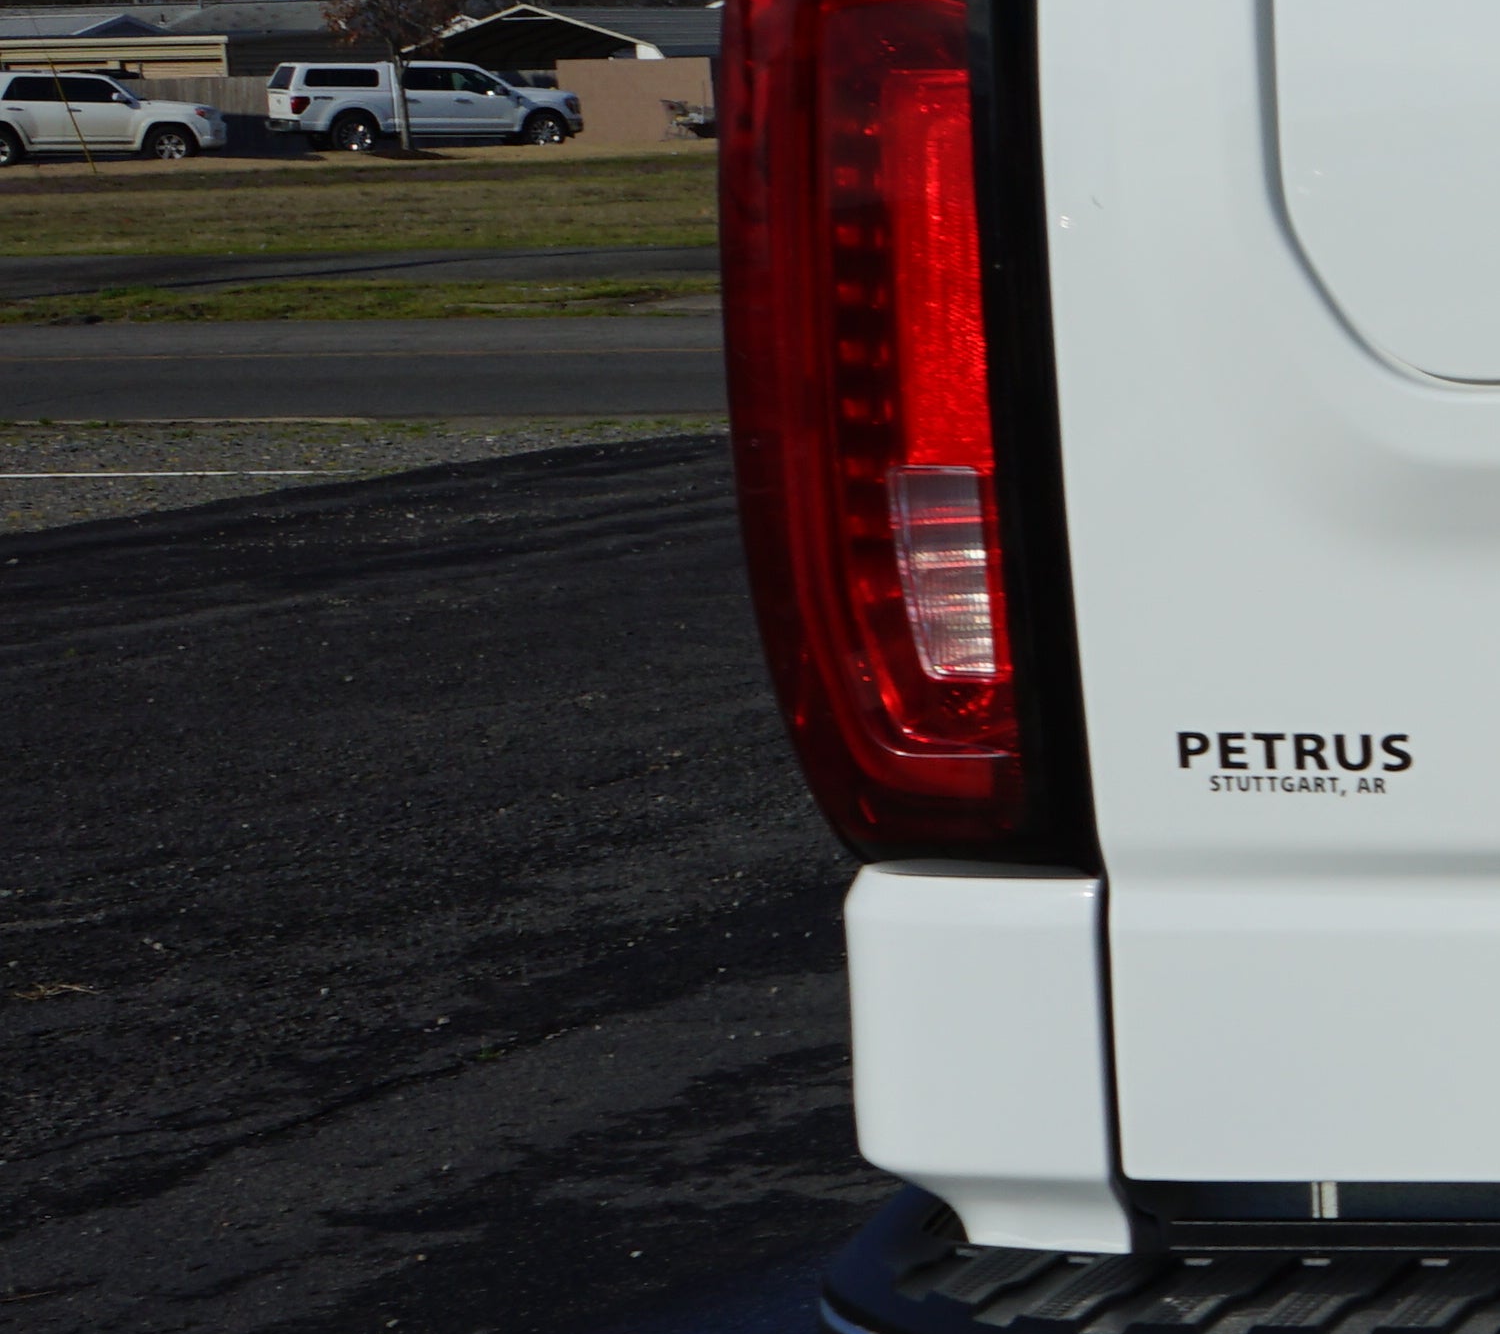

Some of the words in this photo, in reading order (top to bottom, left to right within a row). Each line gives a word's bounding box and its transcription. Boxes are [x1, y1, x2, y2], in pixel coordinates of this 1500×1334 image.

[1175, 731, 1413, 772] PETRUS
[1209, 775, 1347, 797] STUTTGART,
[1356, 776, 1387, 794] AR
